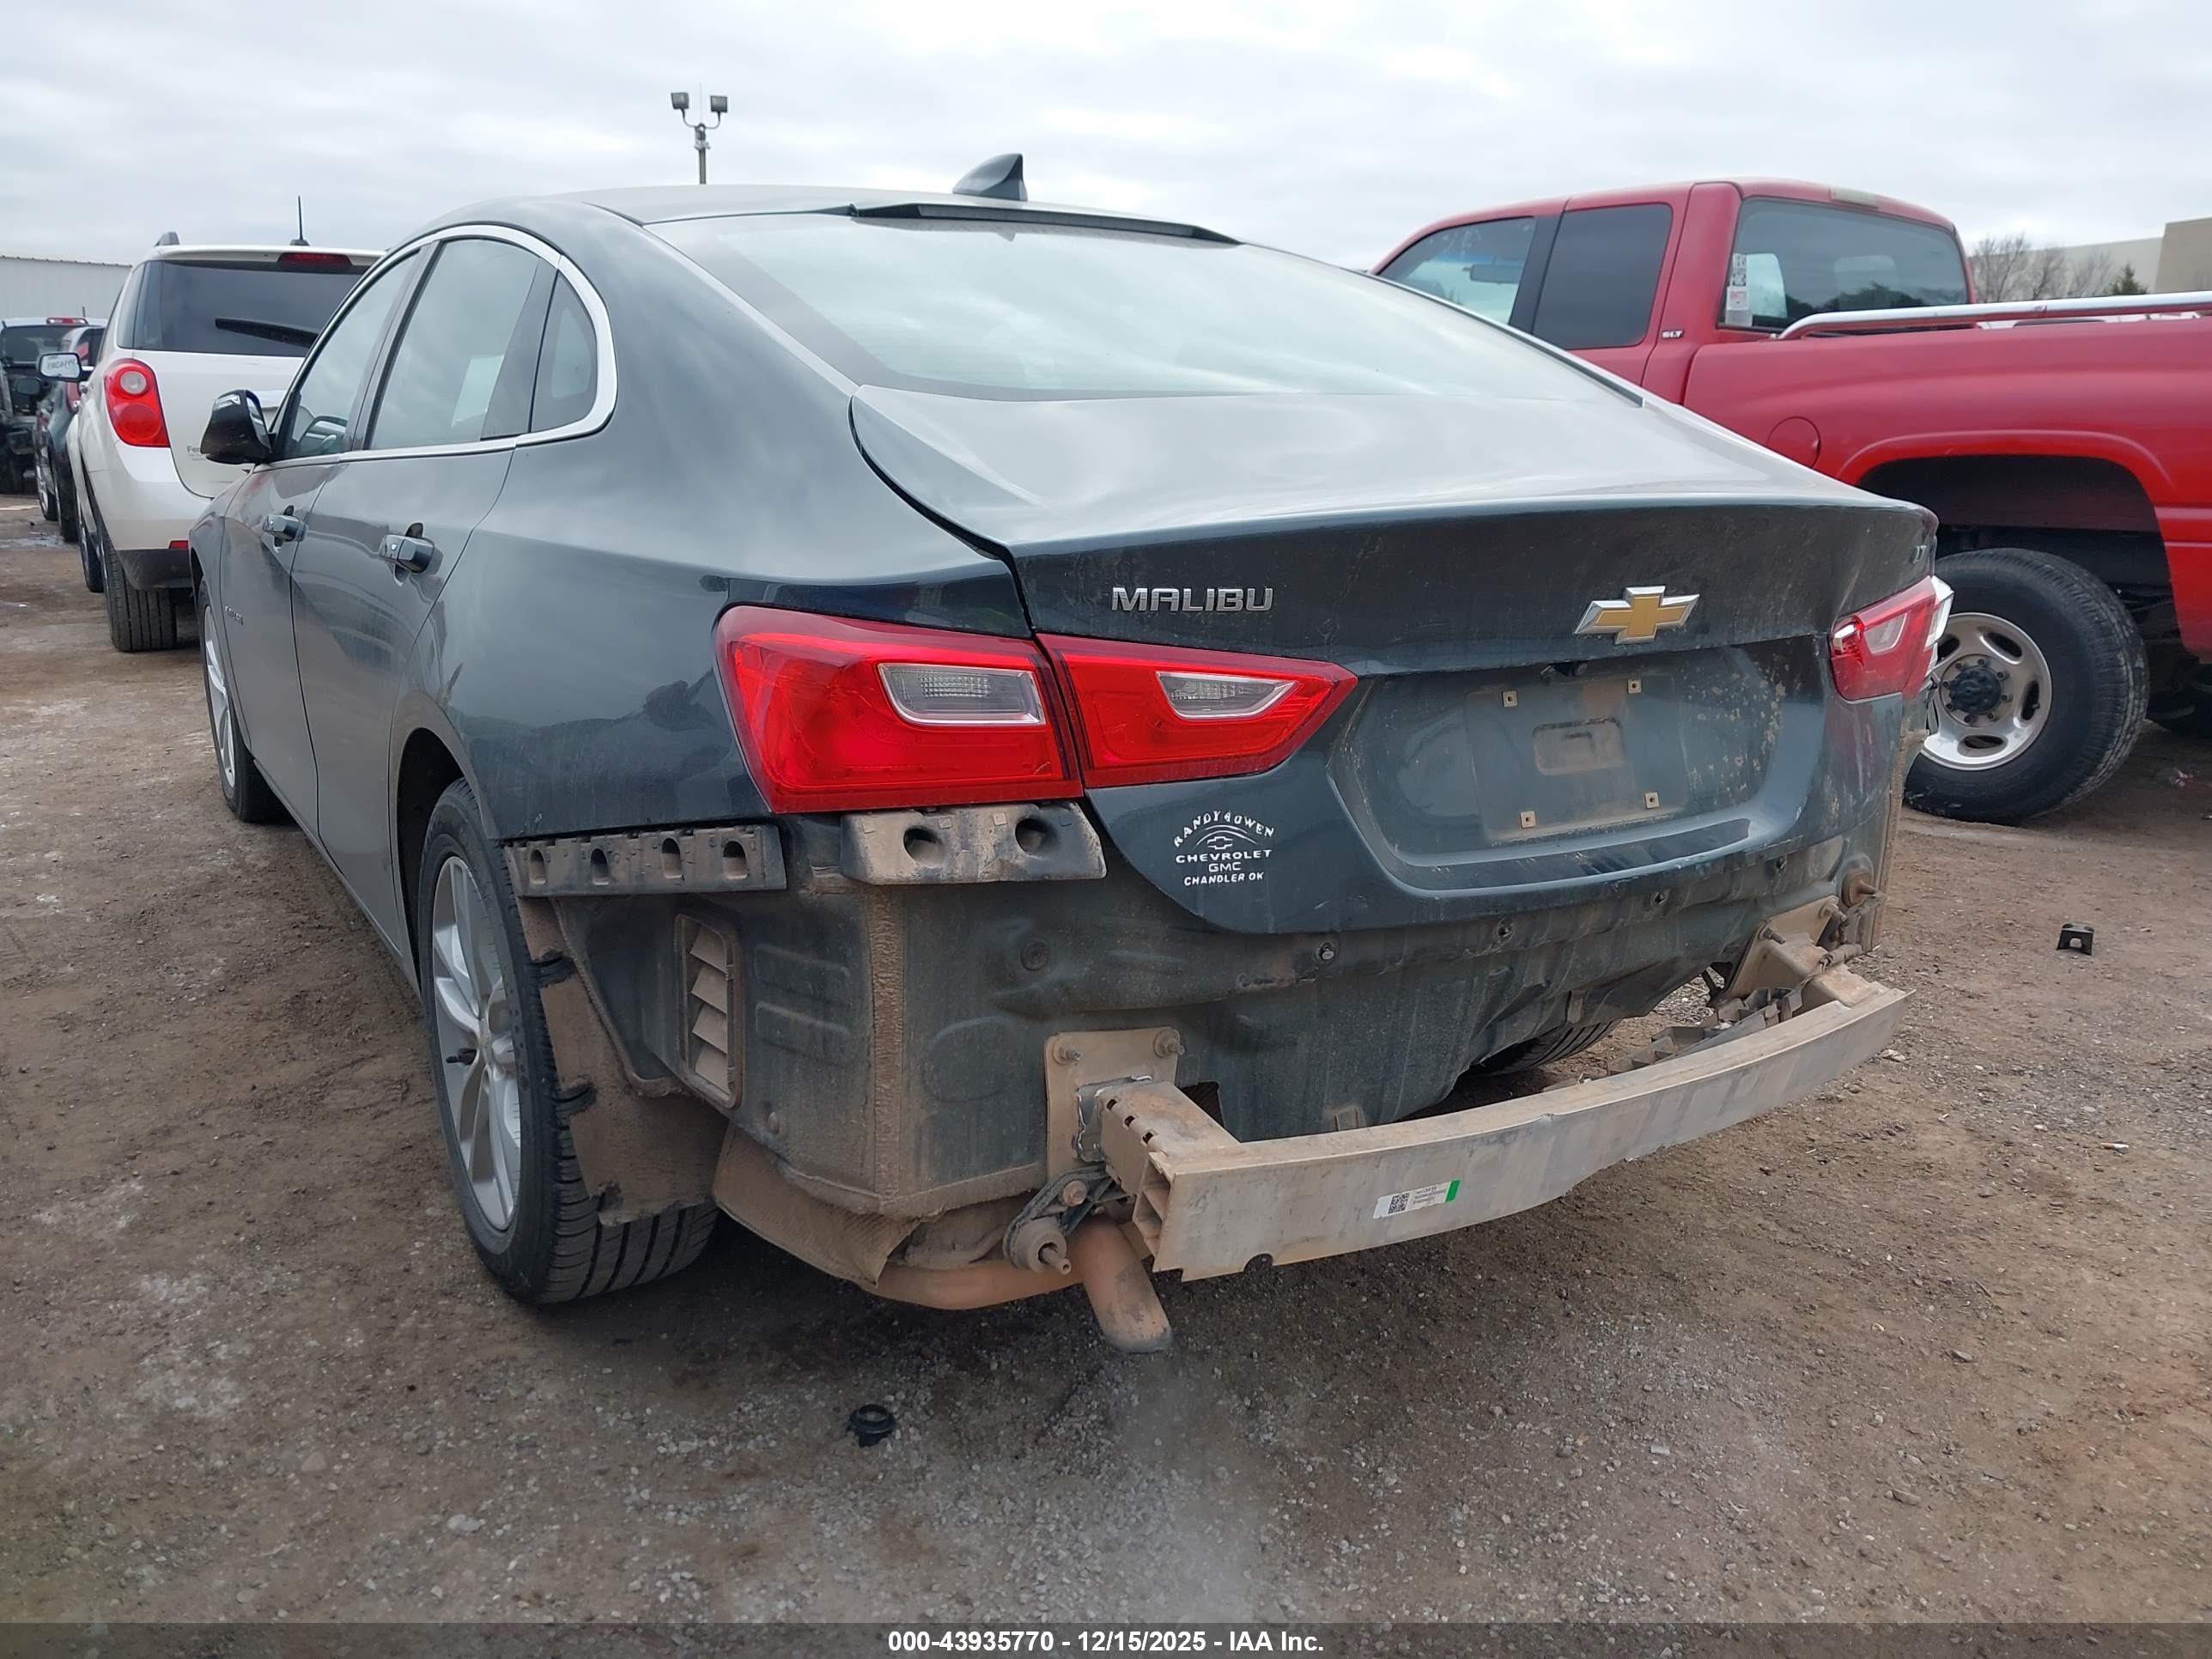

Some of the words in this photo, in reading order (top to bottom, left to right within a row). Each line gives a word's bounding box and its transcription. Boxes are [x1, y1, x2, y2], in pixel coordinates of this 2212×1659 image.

[1662, 330, 1683, 338] SLT
[1111, 586, 1273, 611] MALIBU
[1176, 849, 1272, 864] CHEVROLET
[1208, 861, 1242, 872] GMC
[1184, 872, 1245, 886] CHANDLER
[1249, 872, 1264, 881] OK
